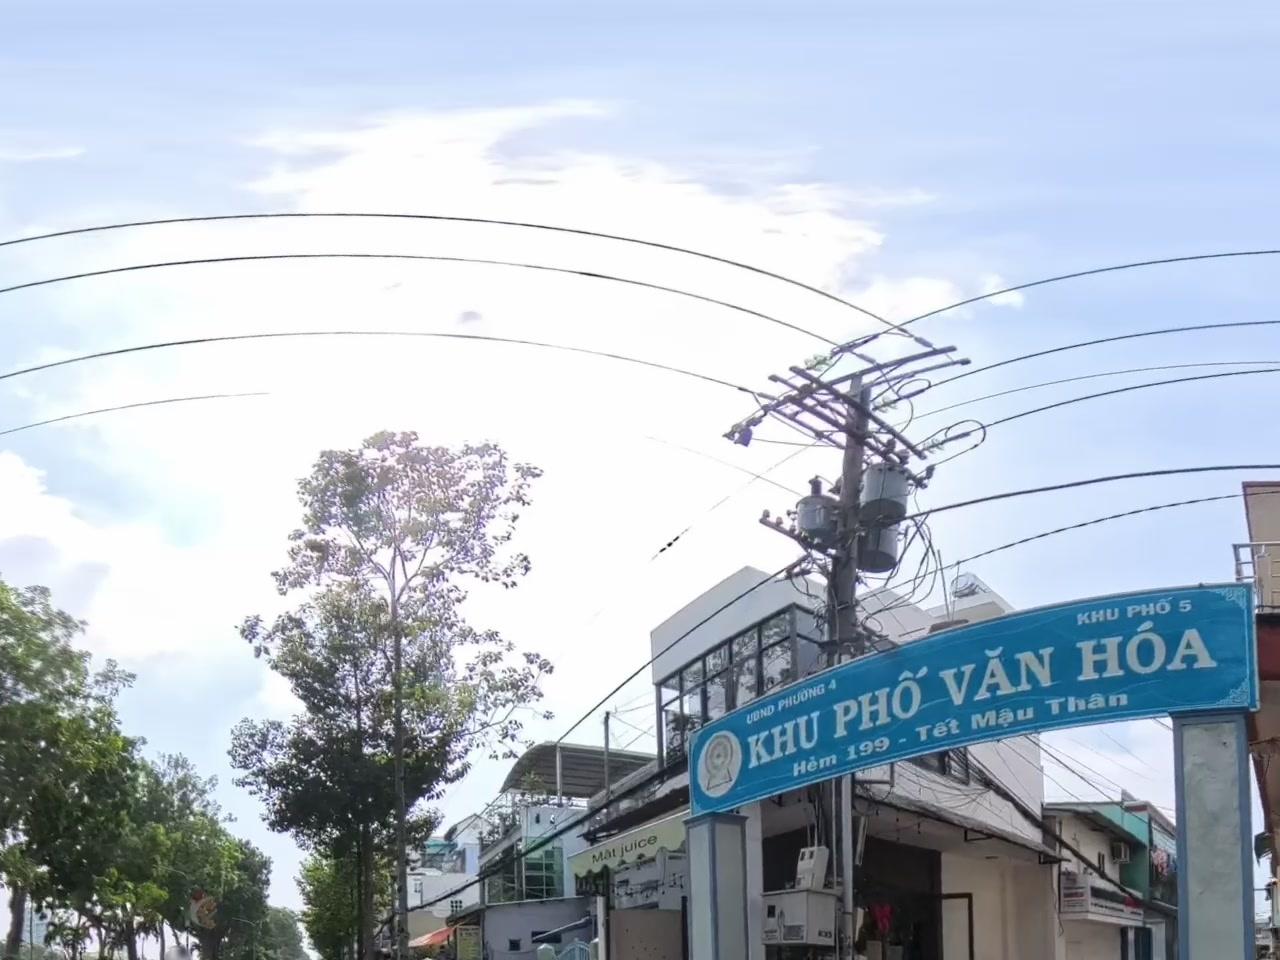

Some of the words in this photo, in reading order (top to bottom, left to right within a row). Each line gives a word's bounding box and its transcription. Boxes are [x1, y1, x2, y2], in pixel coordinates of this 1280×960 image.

[1076, 607, 1120, 625] KHU
[1127, 597, 1173, 618] PHỐ
[1179, 600, 1193, 613] 5
[746, 705, 775, 725] UBND
[828, 679, 837, 690] 4
[747, 711, 820, 769] KHU
[833, 666, 929, 738] PHỐ
[938, 646, 1055, 706] VĂN
[1076, 620, 1217, 681] HÓA
[847, 736, 890, 760] 199
[915, 717, 961, 742] Tết
[971, 707, 1034, 730] Mậu
[1045, 692, 1129, 716] Thân
[620, 835, 658, 857] juice
